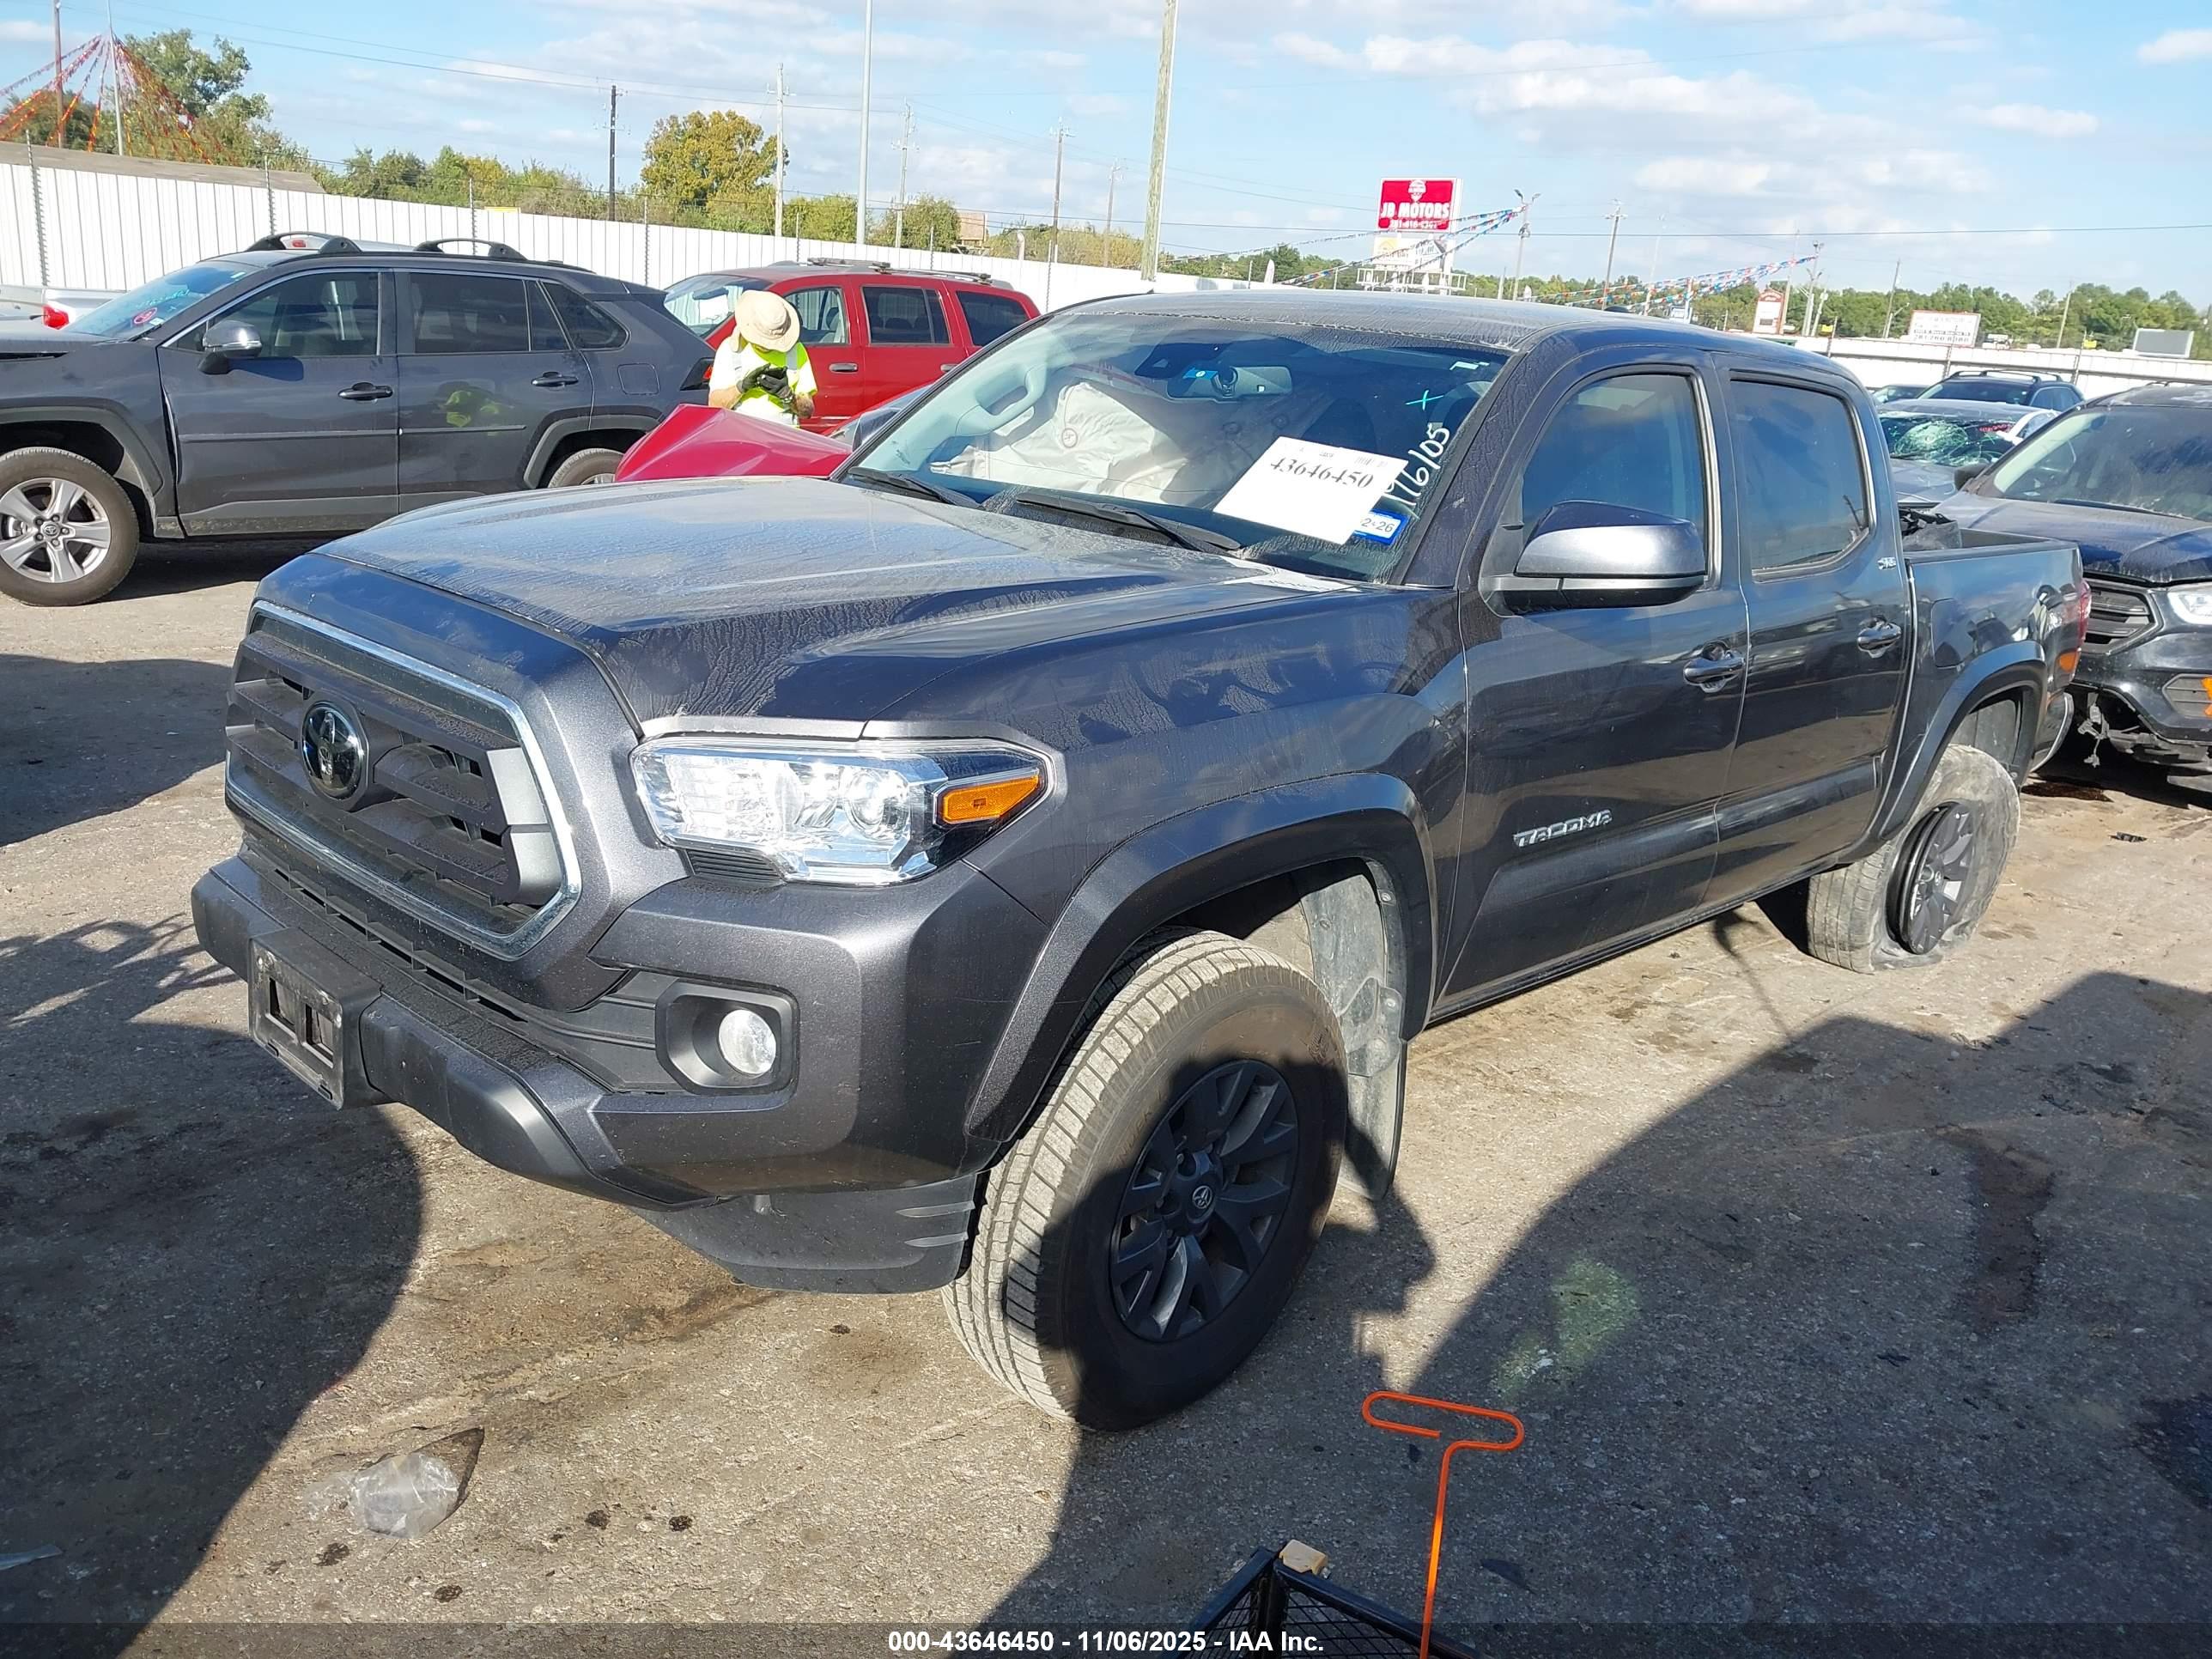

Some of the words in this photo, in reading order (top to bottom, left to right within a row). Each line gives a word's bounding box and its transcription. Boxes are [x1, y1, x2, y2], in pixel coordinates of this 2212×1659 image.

[1381, 203, 1396, 218] JB
[1398, 203, 1450, 219] MOTORS
[1270, 455, 1375, 489] 43646450
[1361, 517, 1395, 533] 2-26
[1513, 809, 1613, 847] TACOMA
